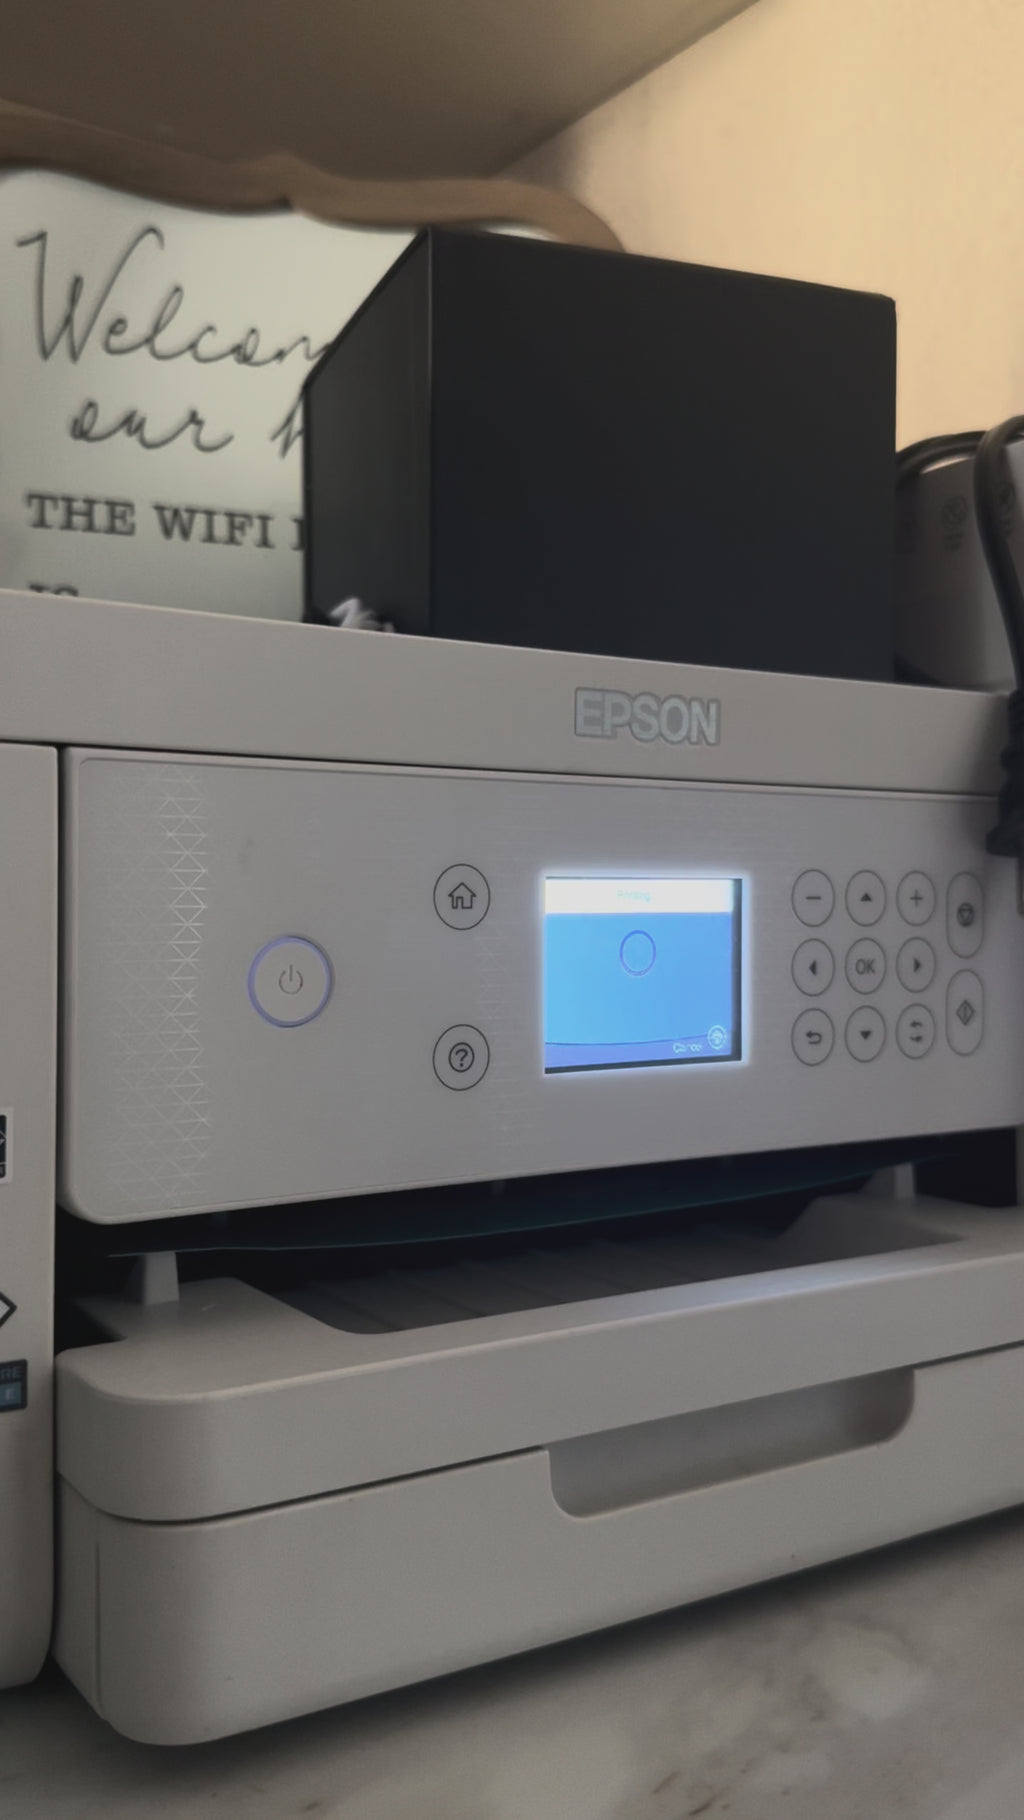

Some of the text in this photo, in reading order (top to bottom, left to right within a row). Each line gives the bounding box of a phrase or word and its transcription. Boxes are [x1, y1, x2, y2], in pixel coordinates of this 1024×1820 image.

[70, 399, 234, 453] our
[26, 493, 137, 537] THE
[153, 504, 275, 549] WIFI
[575, 687, 721, 746] EPSON
[855, 958, 876, 976] OK
